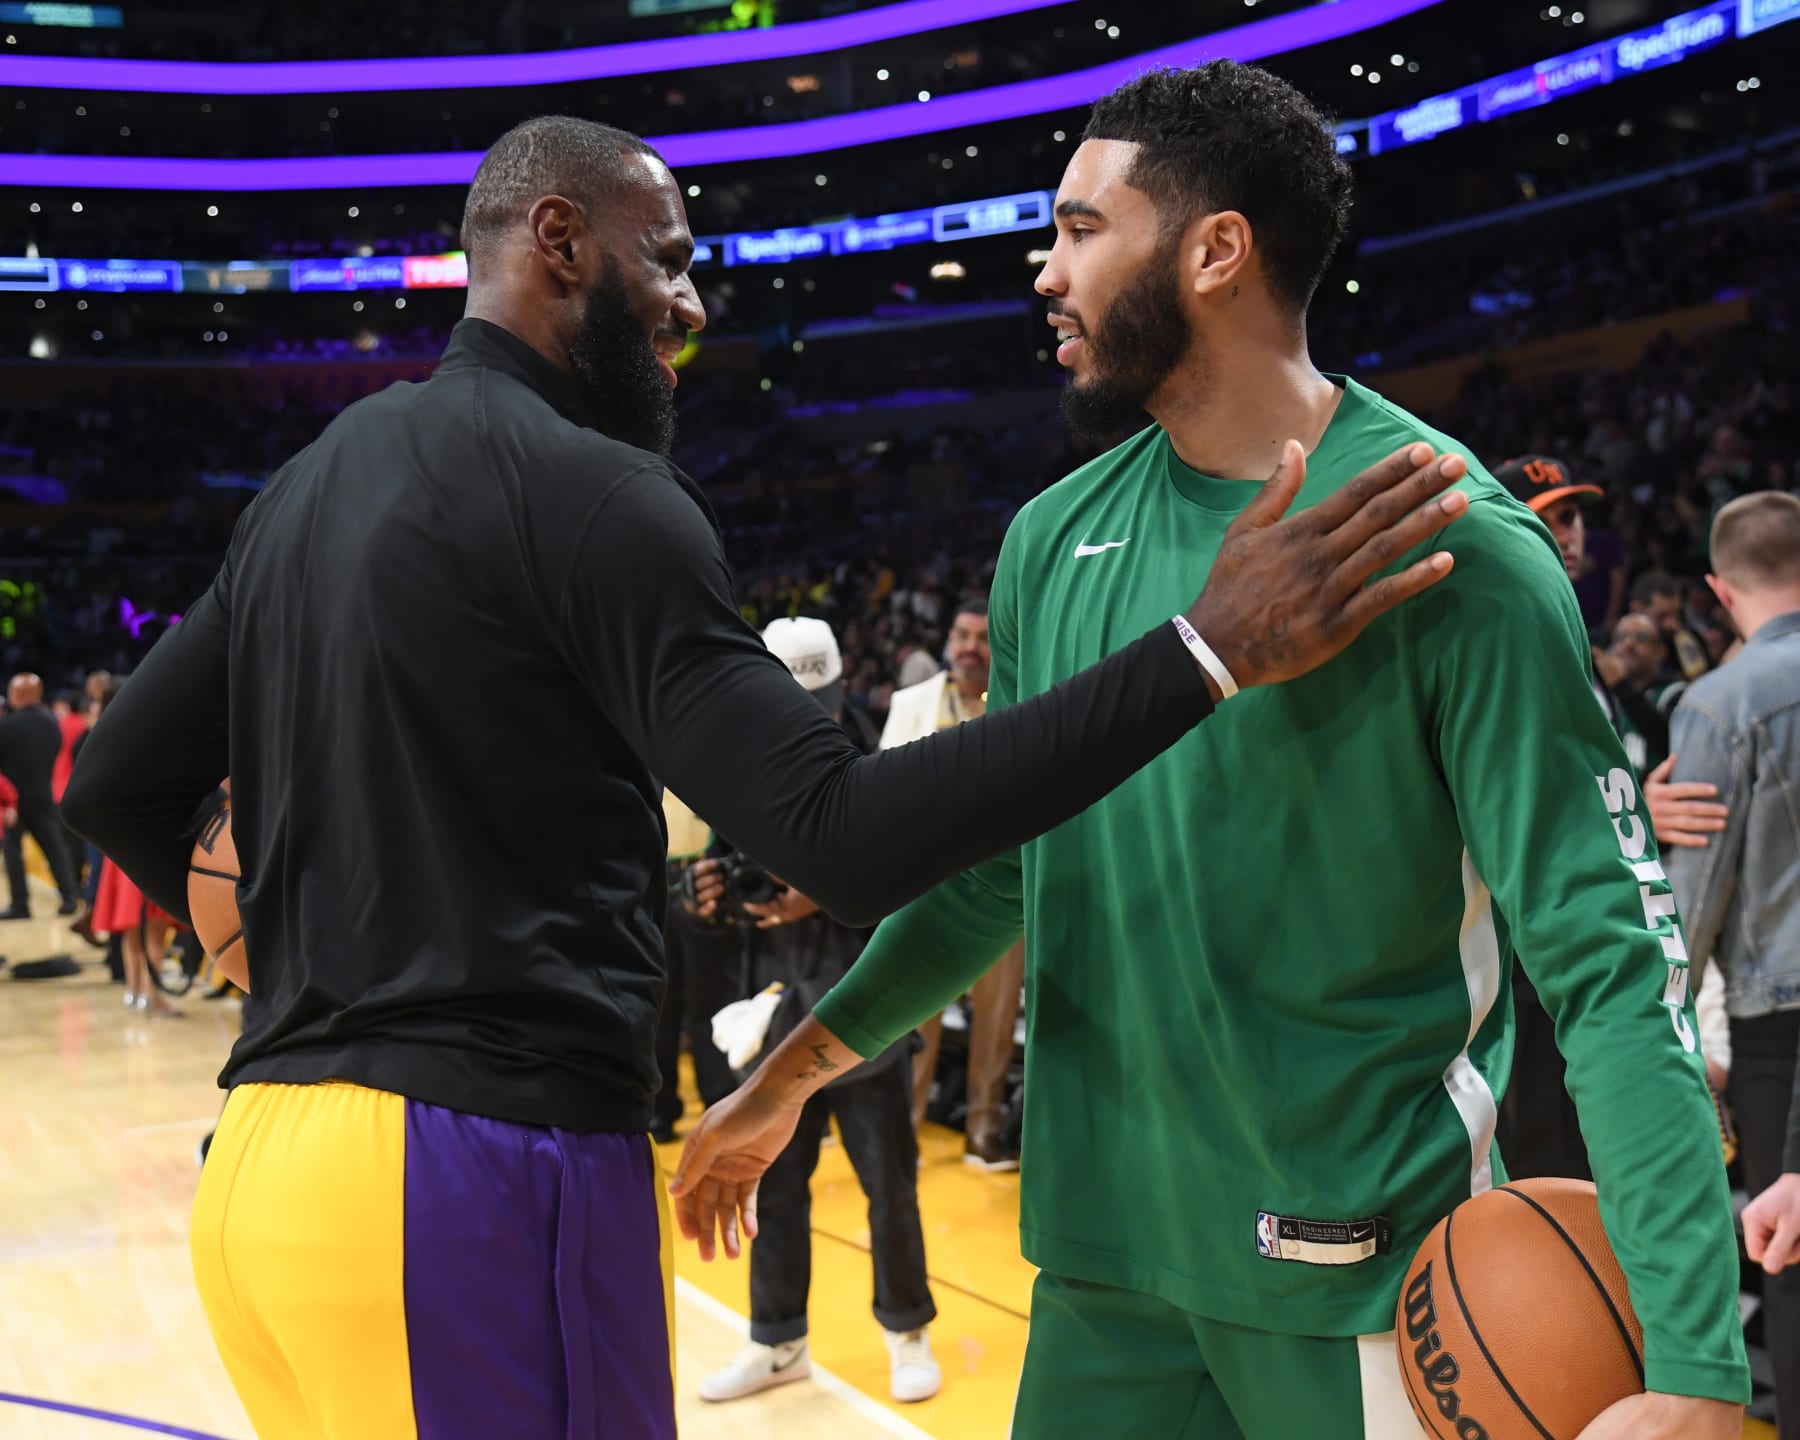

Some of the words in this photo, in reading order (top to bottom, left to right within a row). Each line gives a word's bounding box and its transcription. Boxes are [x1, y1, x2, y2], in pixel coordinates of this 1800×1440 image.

[1596, 767, 1696, 1053] CELTICS
[1282, 1224, 1296, 1235] XL
[1302, 1225, 1346, 1234] ENGINEERED
